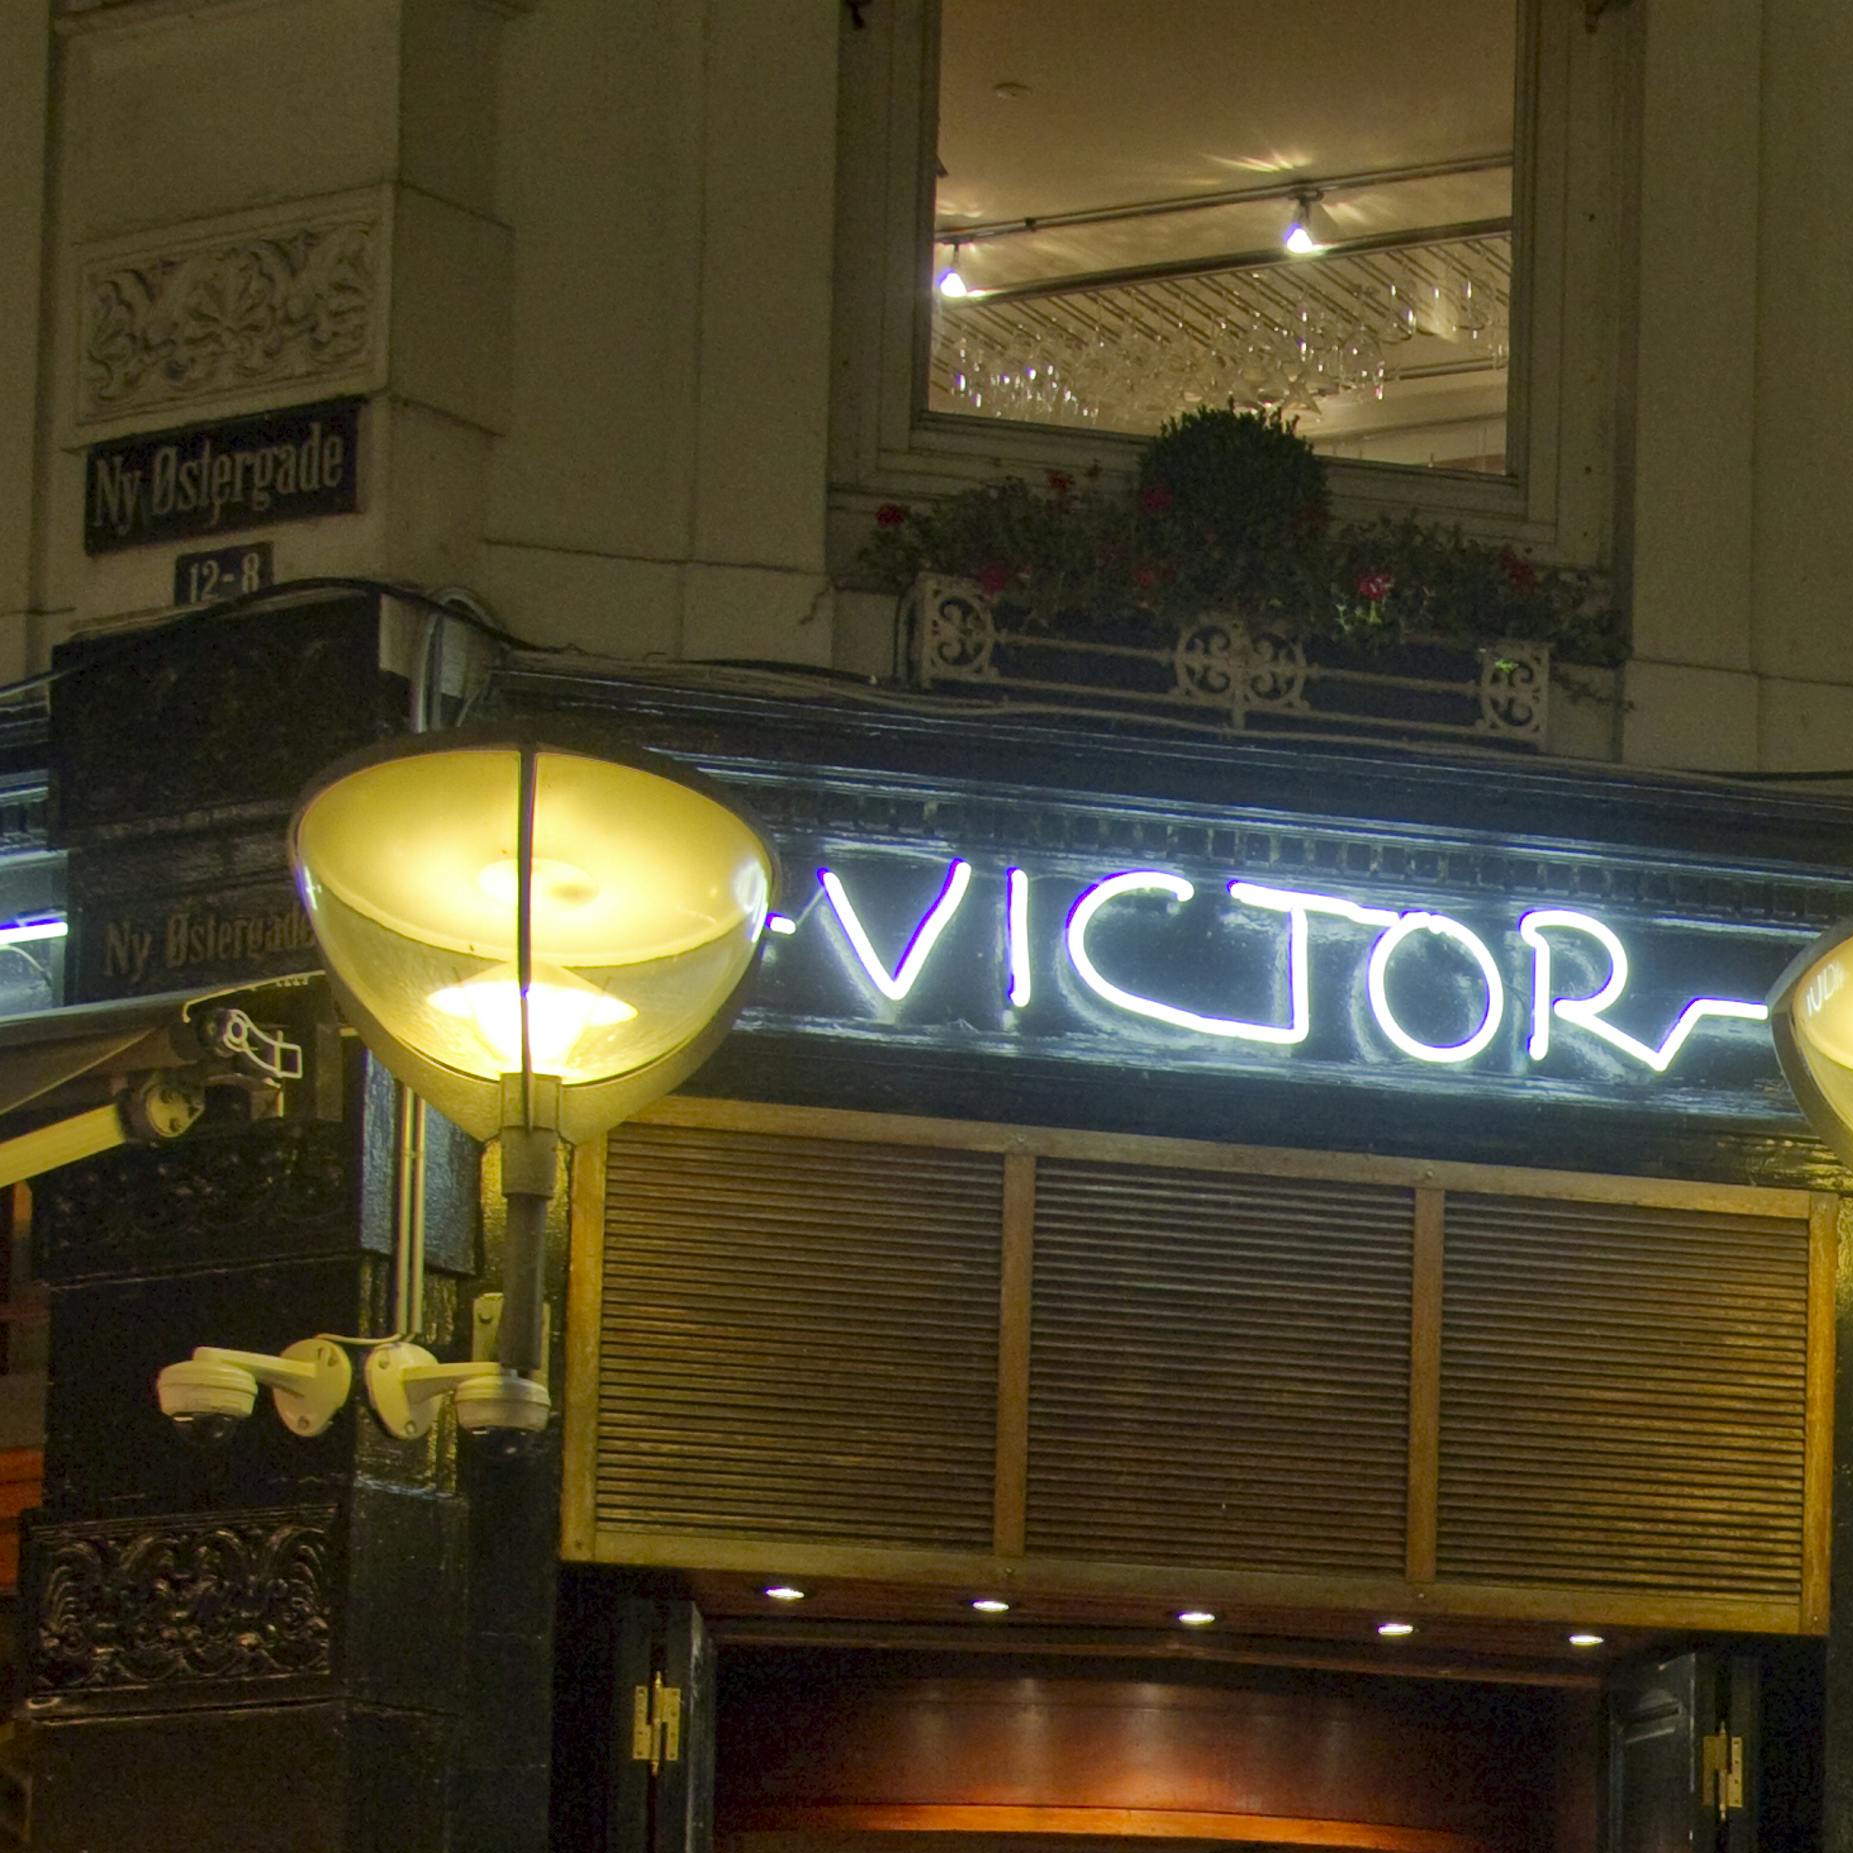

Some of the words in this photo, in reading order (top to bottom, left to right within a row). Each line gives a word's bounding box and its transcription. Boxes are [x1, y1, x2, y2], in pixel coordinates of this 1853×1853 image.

[93, 455, 141, 536] Ny
[152, 421, 345, 513] Østergade
[188, 553, 260, 603] 12-8
[103, 920, 153, 983] Ny
[818, 857, 1680, 1073] VICTOR
